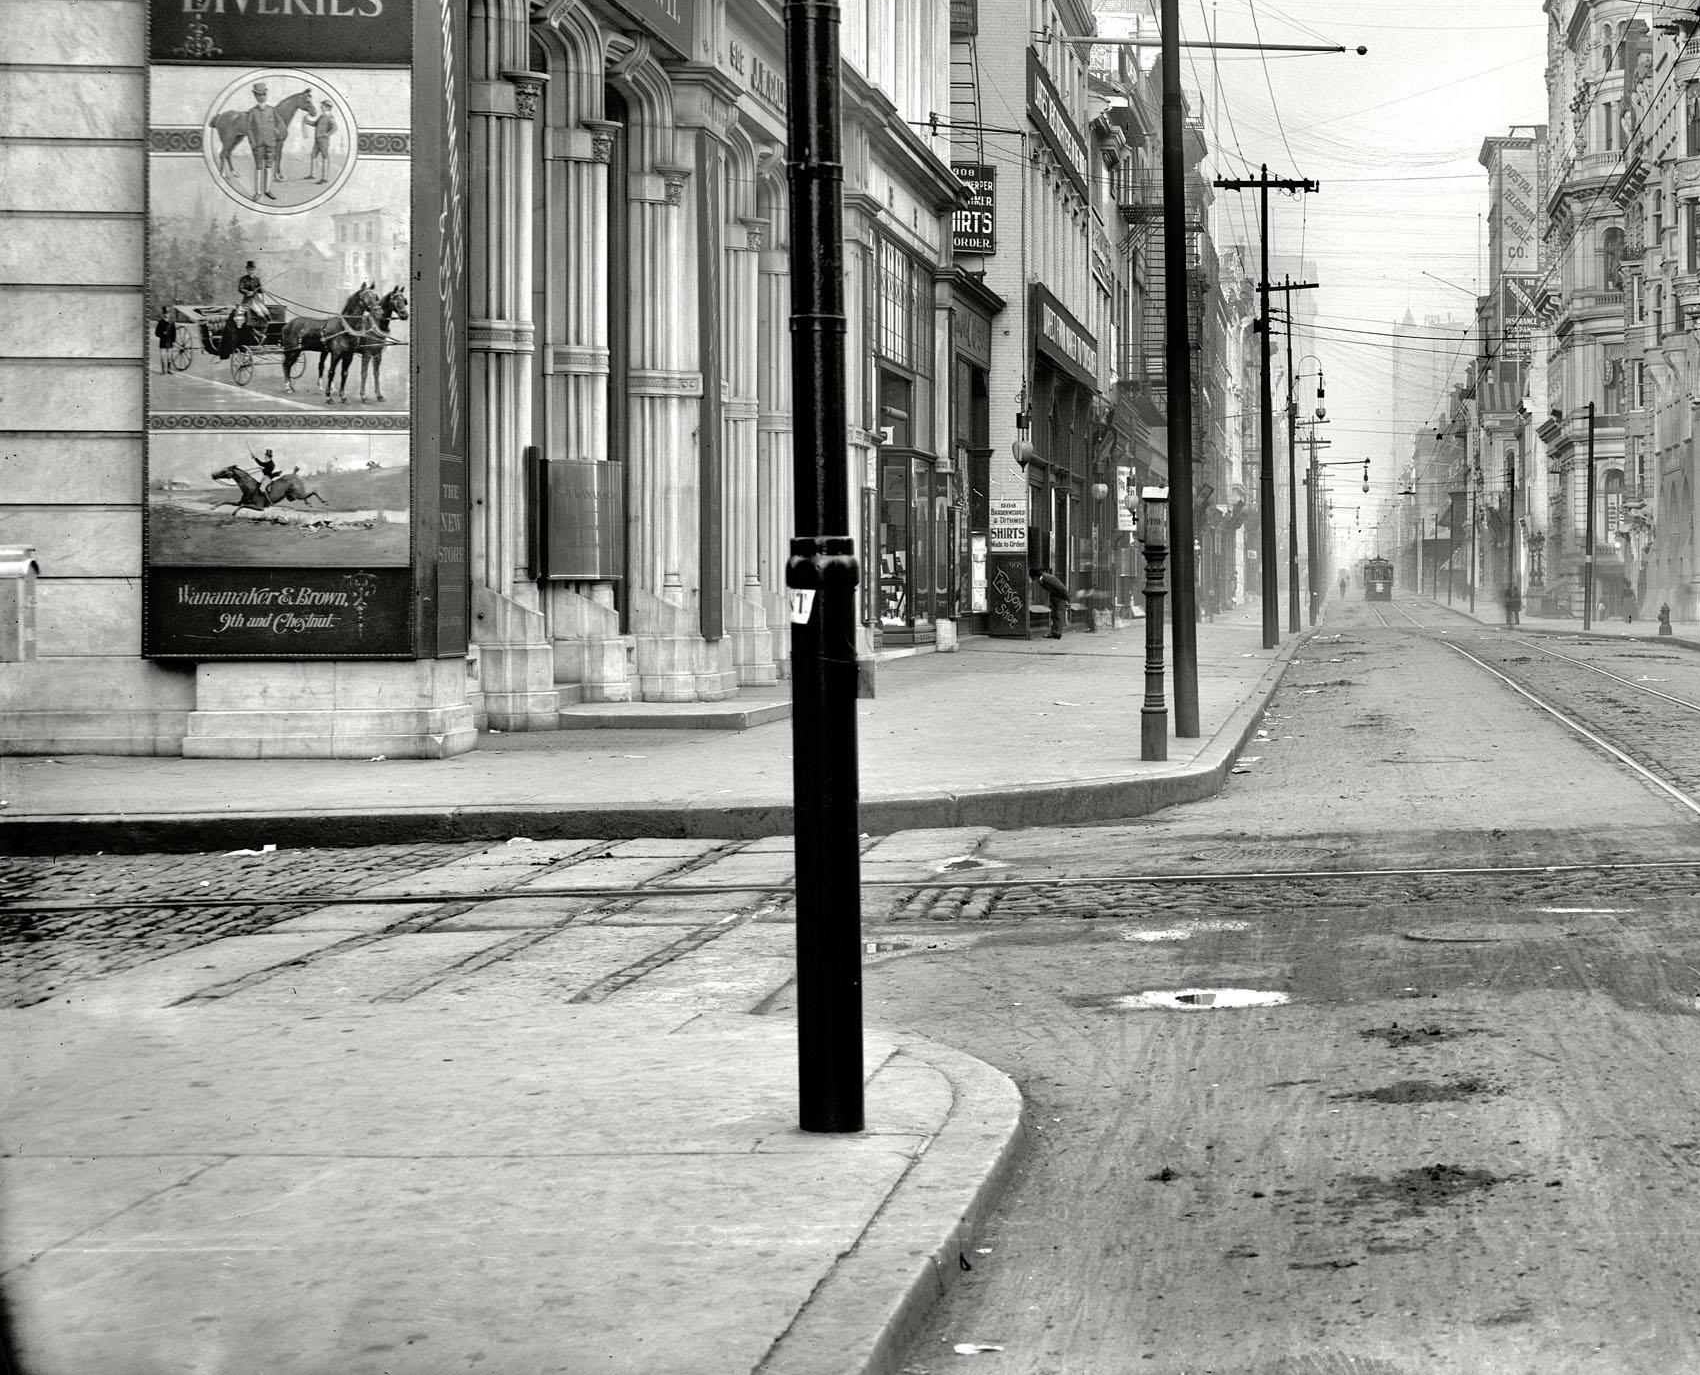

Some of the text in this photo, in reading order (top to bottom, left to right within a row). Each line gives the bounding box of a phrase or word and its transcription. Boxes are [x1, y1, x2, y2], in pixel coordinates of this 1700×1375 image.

[952, 167, 975, 177] 908
[1502, 163, 1534, 198] POSTAL
[952, 210, 993, 234] IRTS
[1503, 214, 1535, 246] CABLE
[953, 237, 992, 248] ORDER.
[1508, 246, 1529, 259] CO.
[442, 483, 460, 500] THE
[440, 512, 462, 533] NEW
[1000, 516, 1026, 524] DITHMER
[990, 527, 1026, 540] SHIRTS
[990, 540, 1004, 548] Made
[439, 545, 465, 563] STORE
[178, 584, 349, 607] Wanamaker & Brown,
[992, 566, 1024, 613] EMERSON
[212, 612, 342, 634] 9th and Chestnut.
[995, 602, 1019, 630] SHOE
